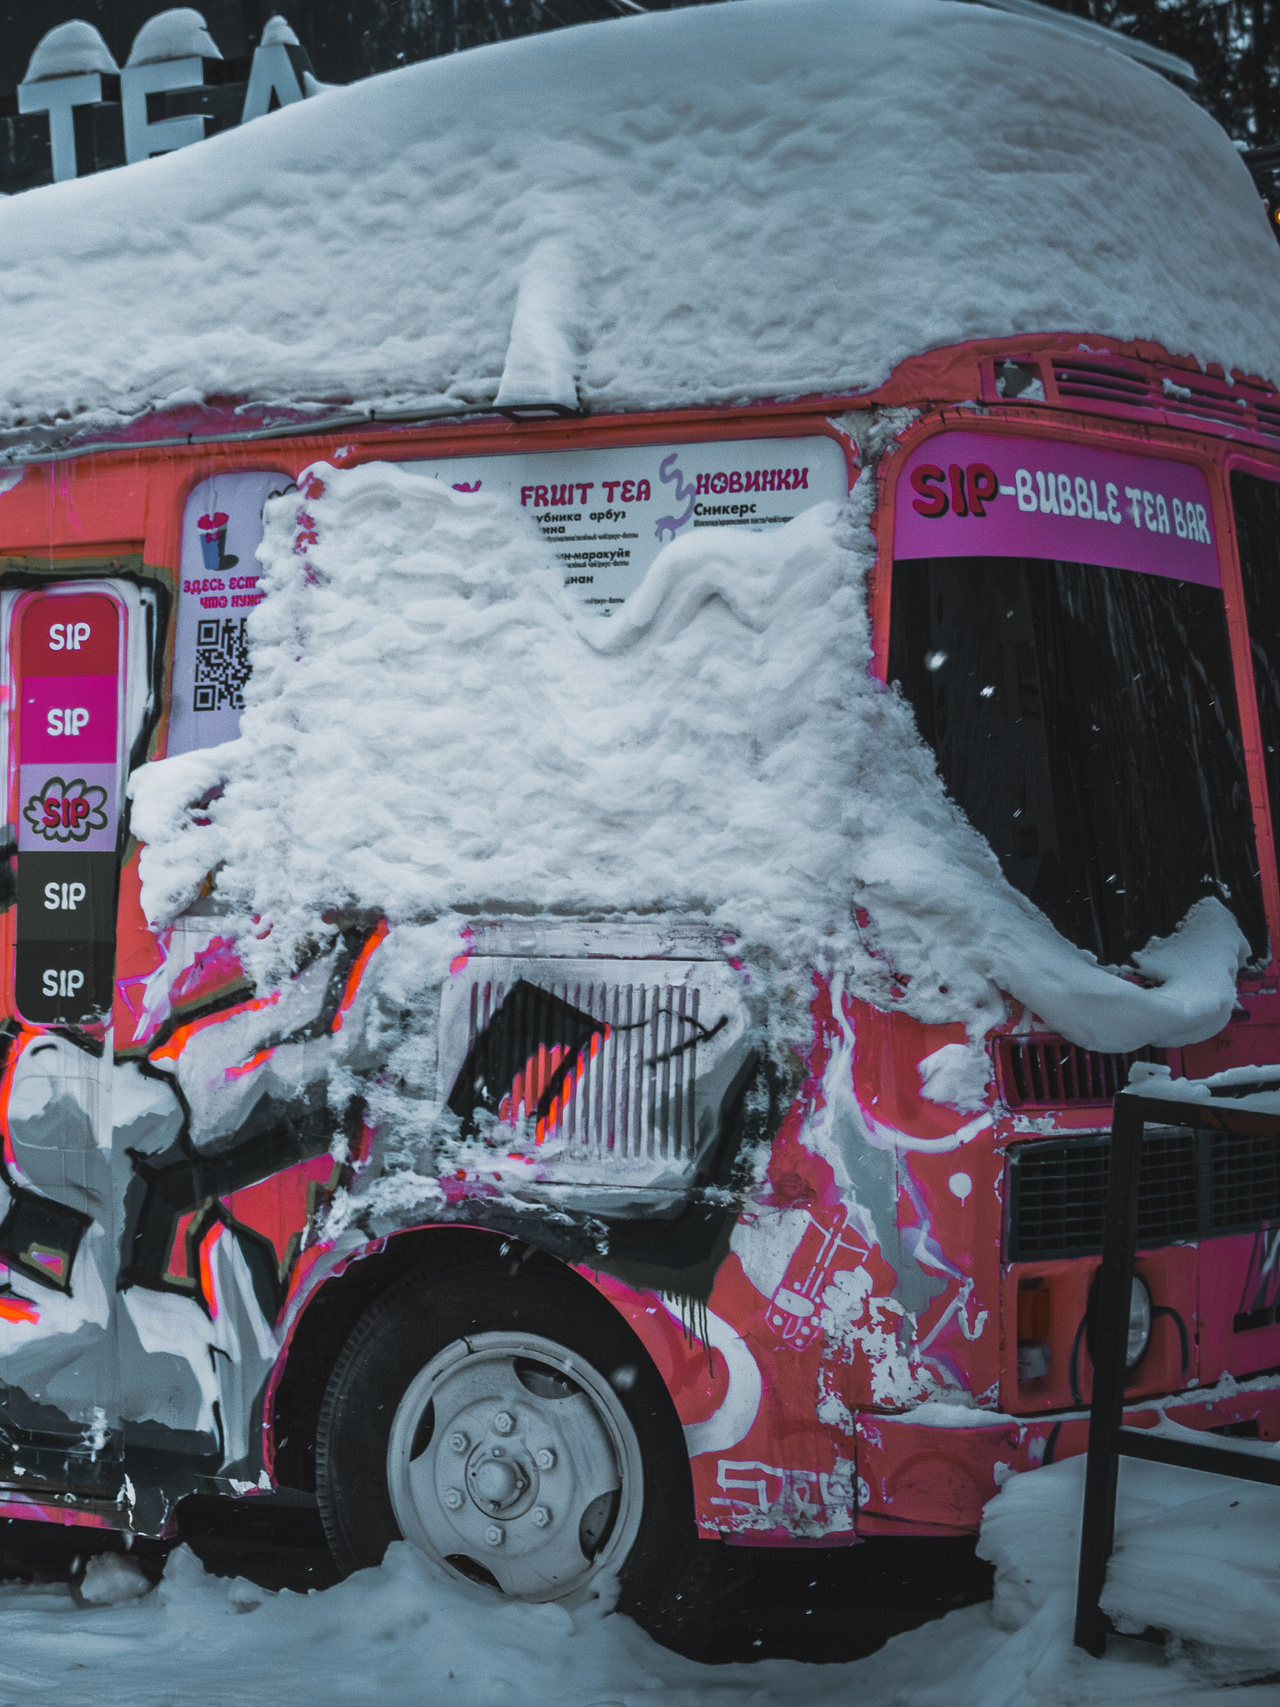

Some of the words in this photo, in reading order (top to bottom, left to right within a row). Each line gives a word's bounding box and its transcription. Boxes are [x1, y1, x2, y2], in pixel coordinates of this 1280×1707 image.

[17, 43, 306, 184] TEA
[521, 482, 594, 507] FRUIT
[602, 479, 651, 503] TEA
[695, 467, 810, 498] НОВИНКИ
[589, 509, 627, 523] арбуз
[694, 502, 758, 518] Сникерс
[1125, 485, 1171, 536] TEA
[1172, 498, 1212, 545] BAR
[183, 578, 226, 596] ЗДЕСЬ
[228, 576, 260, 590] ЕСТ
[49, 622, 91, 650] SIP
[47, 708, 89, 736] SIP
[43, 797, 88, 829] SIP
[44, 882, 86, 911] SIP
[42, 969, 84, 997] SIP
